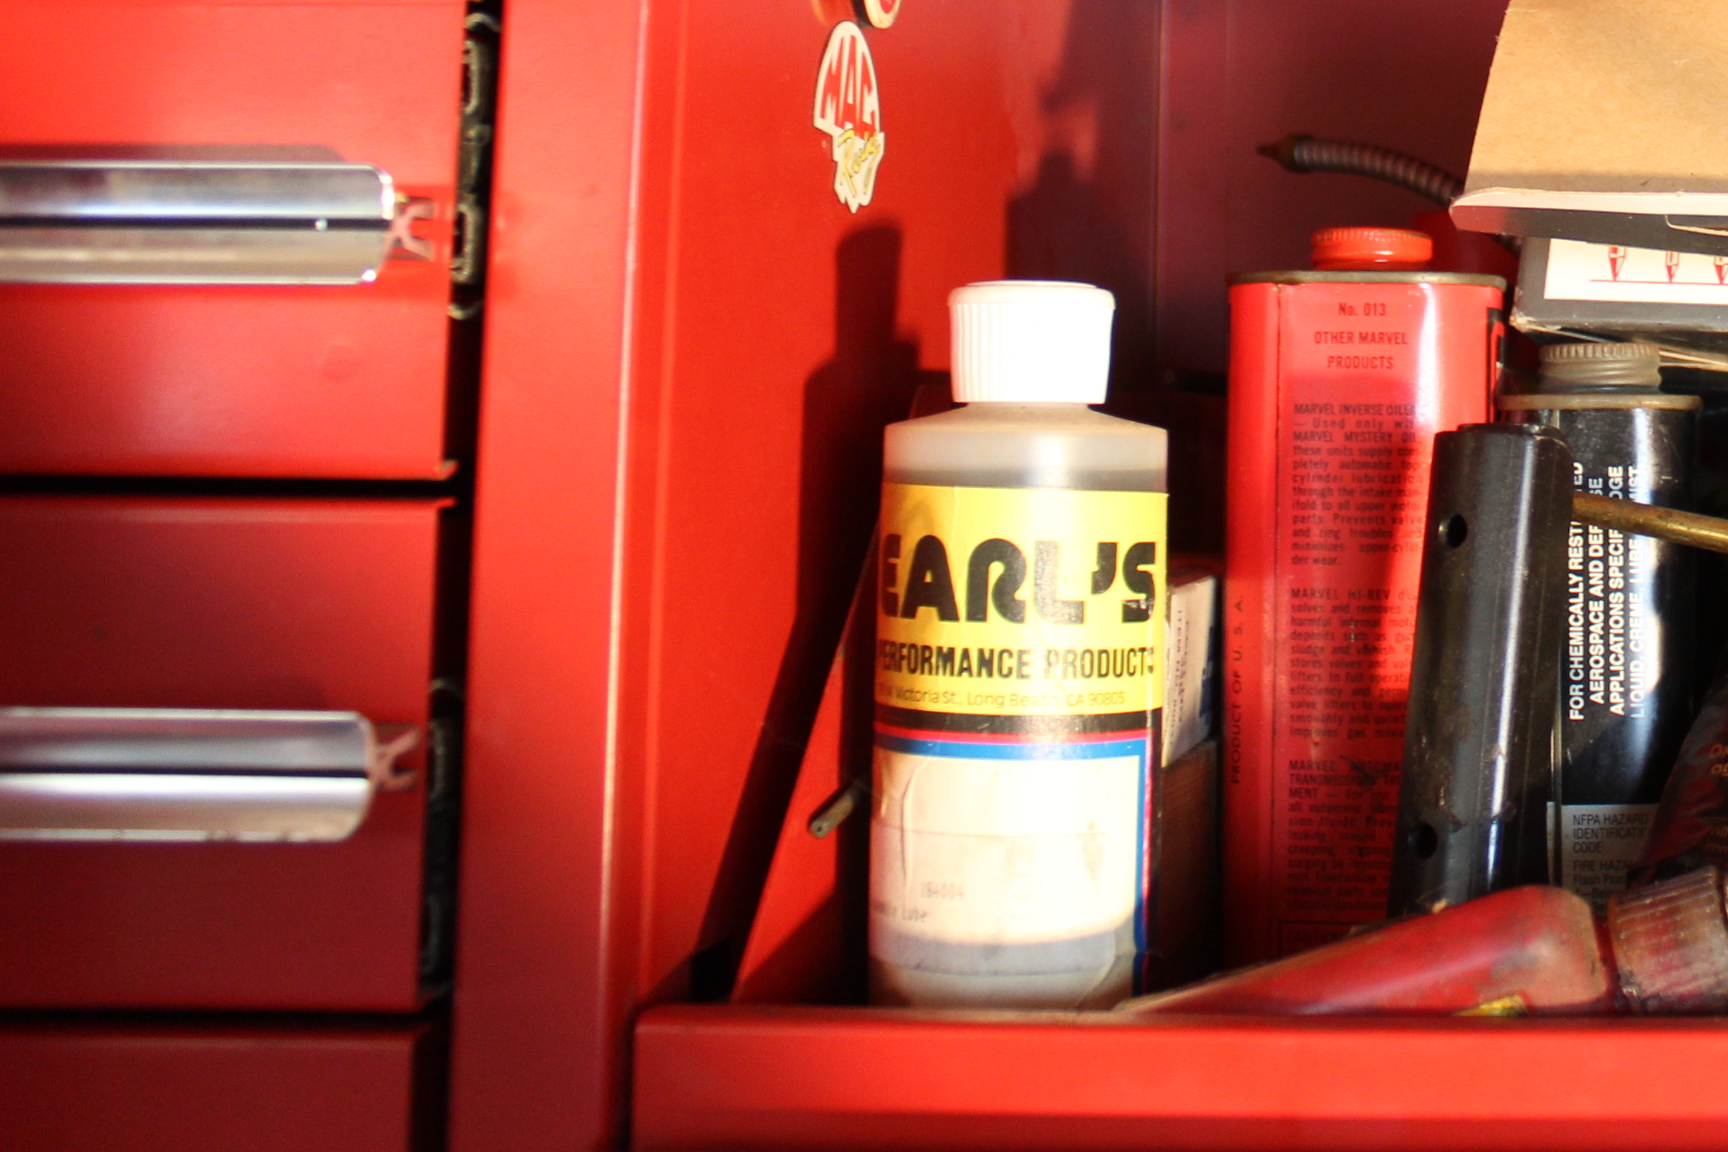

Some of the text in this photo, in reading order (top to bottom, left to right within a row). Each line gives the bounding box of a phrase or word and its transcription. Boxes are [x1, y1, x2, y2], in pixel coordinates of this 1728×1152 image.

[820, 33, 877, 141] MAC
[1363, 302, 1387, 317] 013
[1314, 331, 1408, 346] OTHER MARVEL
[1327, 356, 1394, 370] PRODUCTS
[881, 532, 1157, 625] EARL'S
[1568, 573, 1585, 722] FOR CHEMICALLY
[1588, 559, 1605, 705] AEROSPACE AND
[1608, 528, 1626, 717] APPLICATIONS SPECIF
[1573, 813, 1649, 826] NFPA HAZARD
[1573, 841, 1602, 854] CODE
